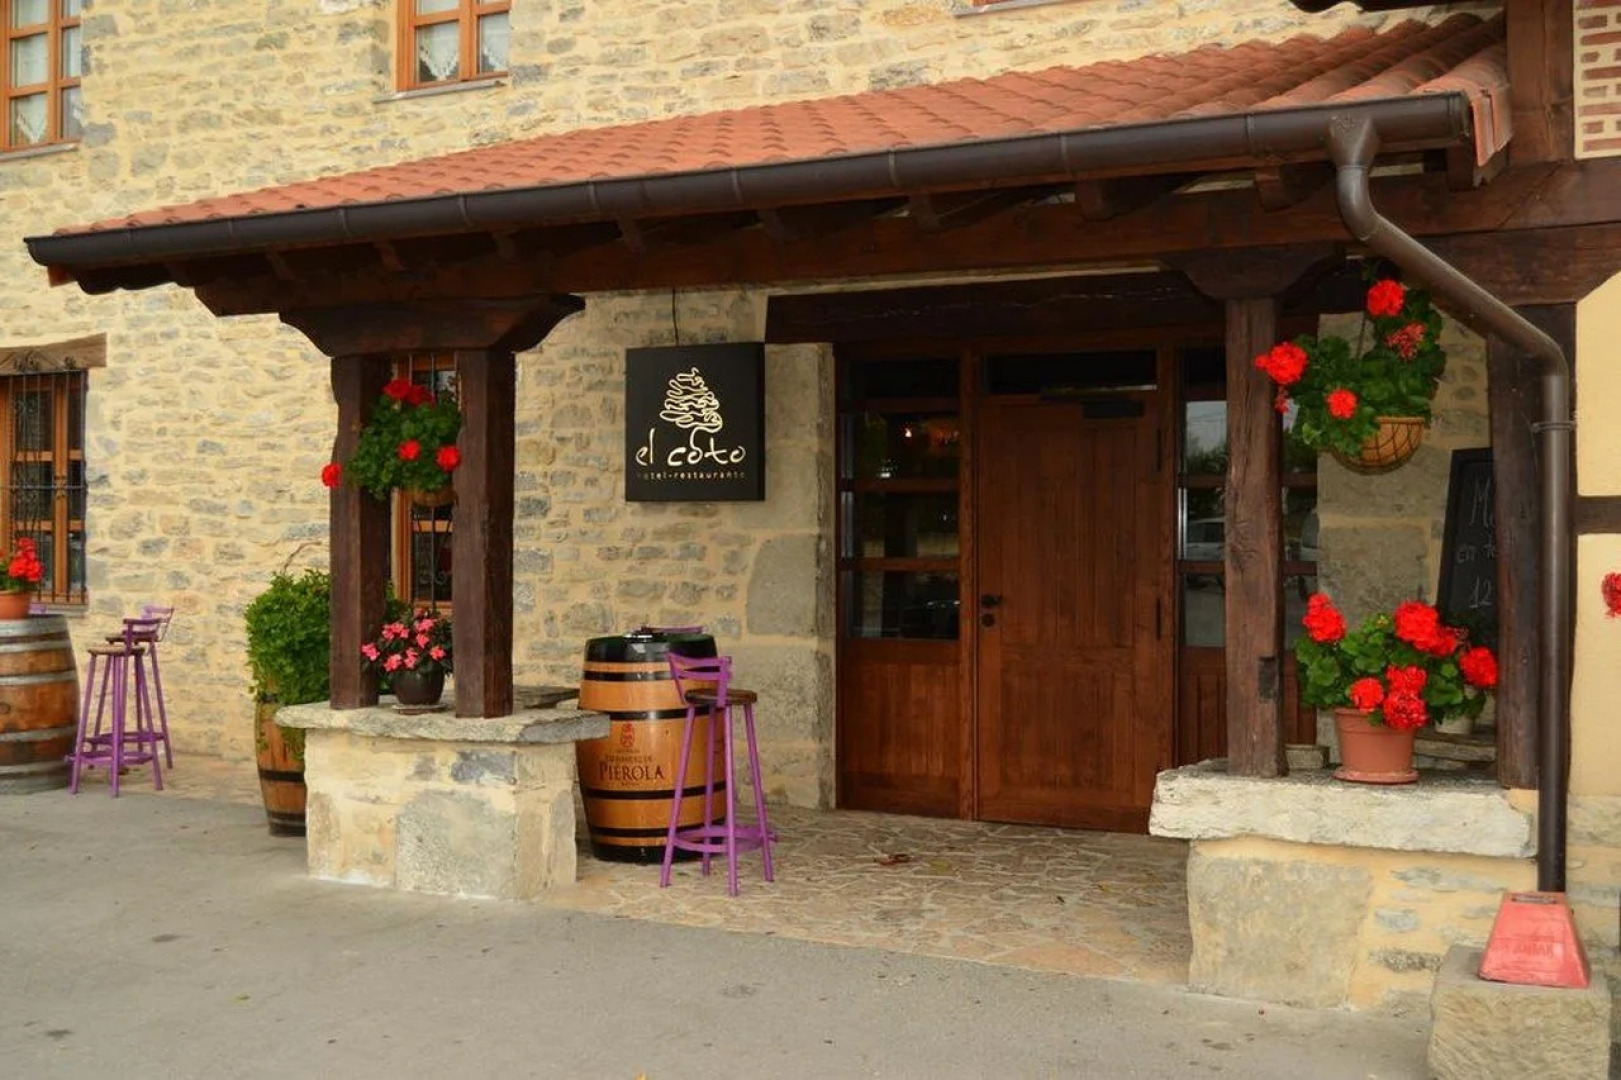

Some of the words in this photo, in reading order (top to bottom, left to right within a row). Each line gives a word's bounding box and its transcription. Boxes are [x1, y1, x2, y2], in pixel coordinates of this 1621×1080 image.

[636, 428, 655, 466] el
[667, 434, 746, 467] coto
[599, 760, 665, 781] PIEROLA
